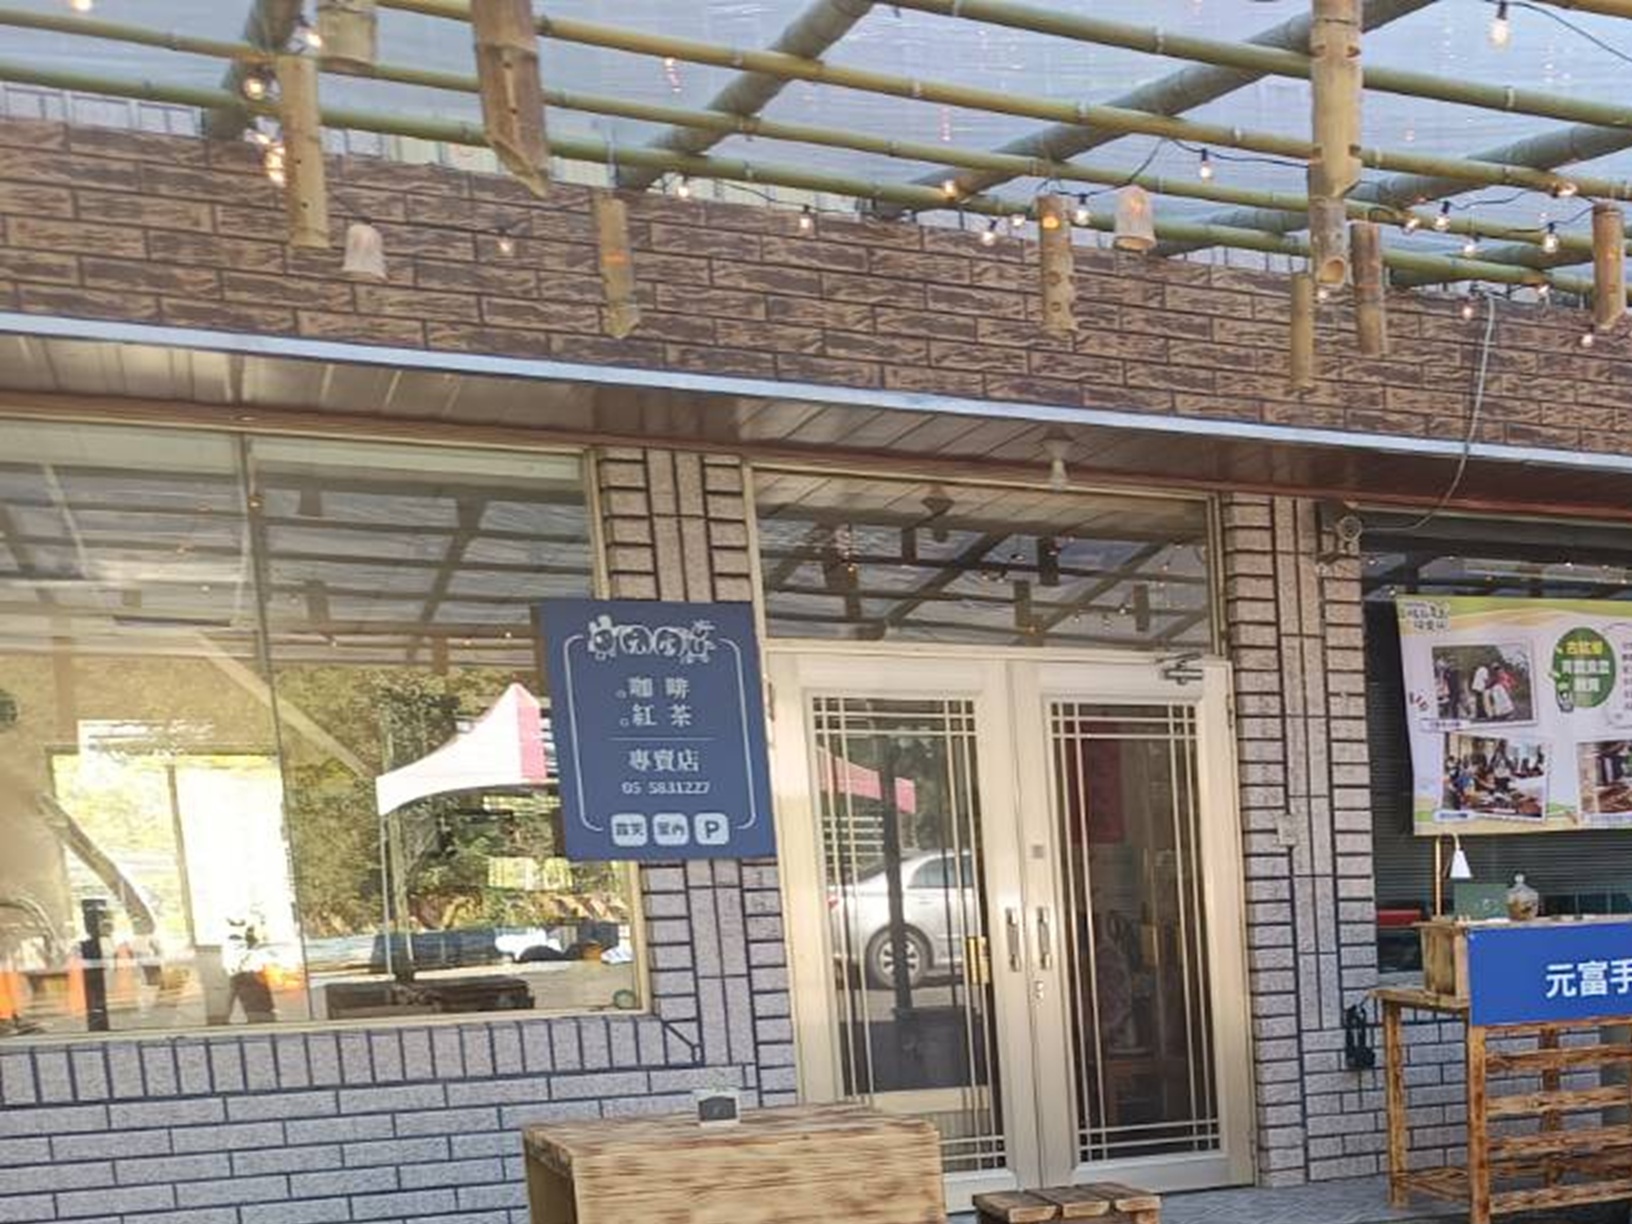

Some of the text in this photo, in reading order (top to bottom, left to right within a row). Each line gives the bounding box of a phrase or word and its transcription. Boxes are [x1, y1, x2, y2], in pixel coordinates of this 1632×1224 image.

[628, 676, 690, 700] 咖啡
[632, 703, 692, 728] 紅茶
[628, 748, 700, 773] 專賣店
[621, 780, 642, 795] 05
[704, 820, 720, 839] P
